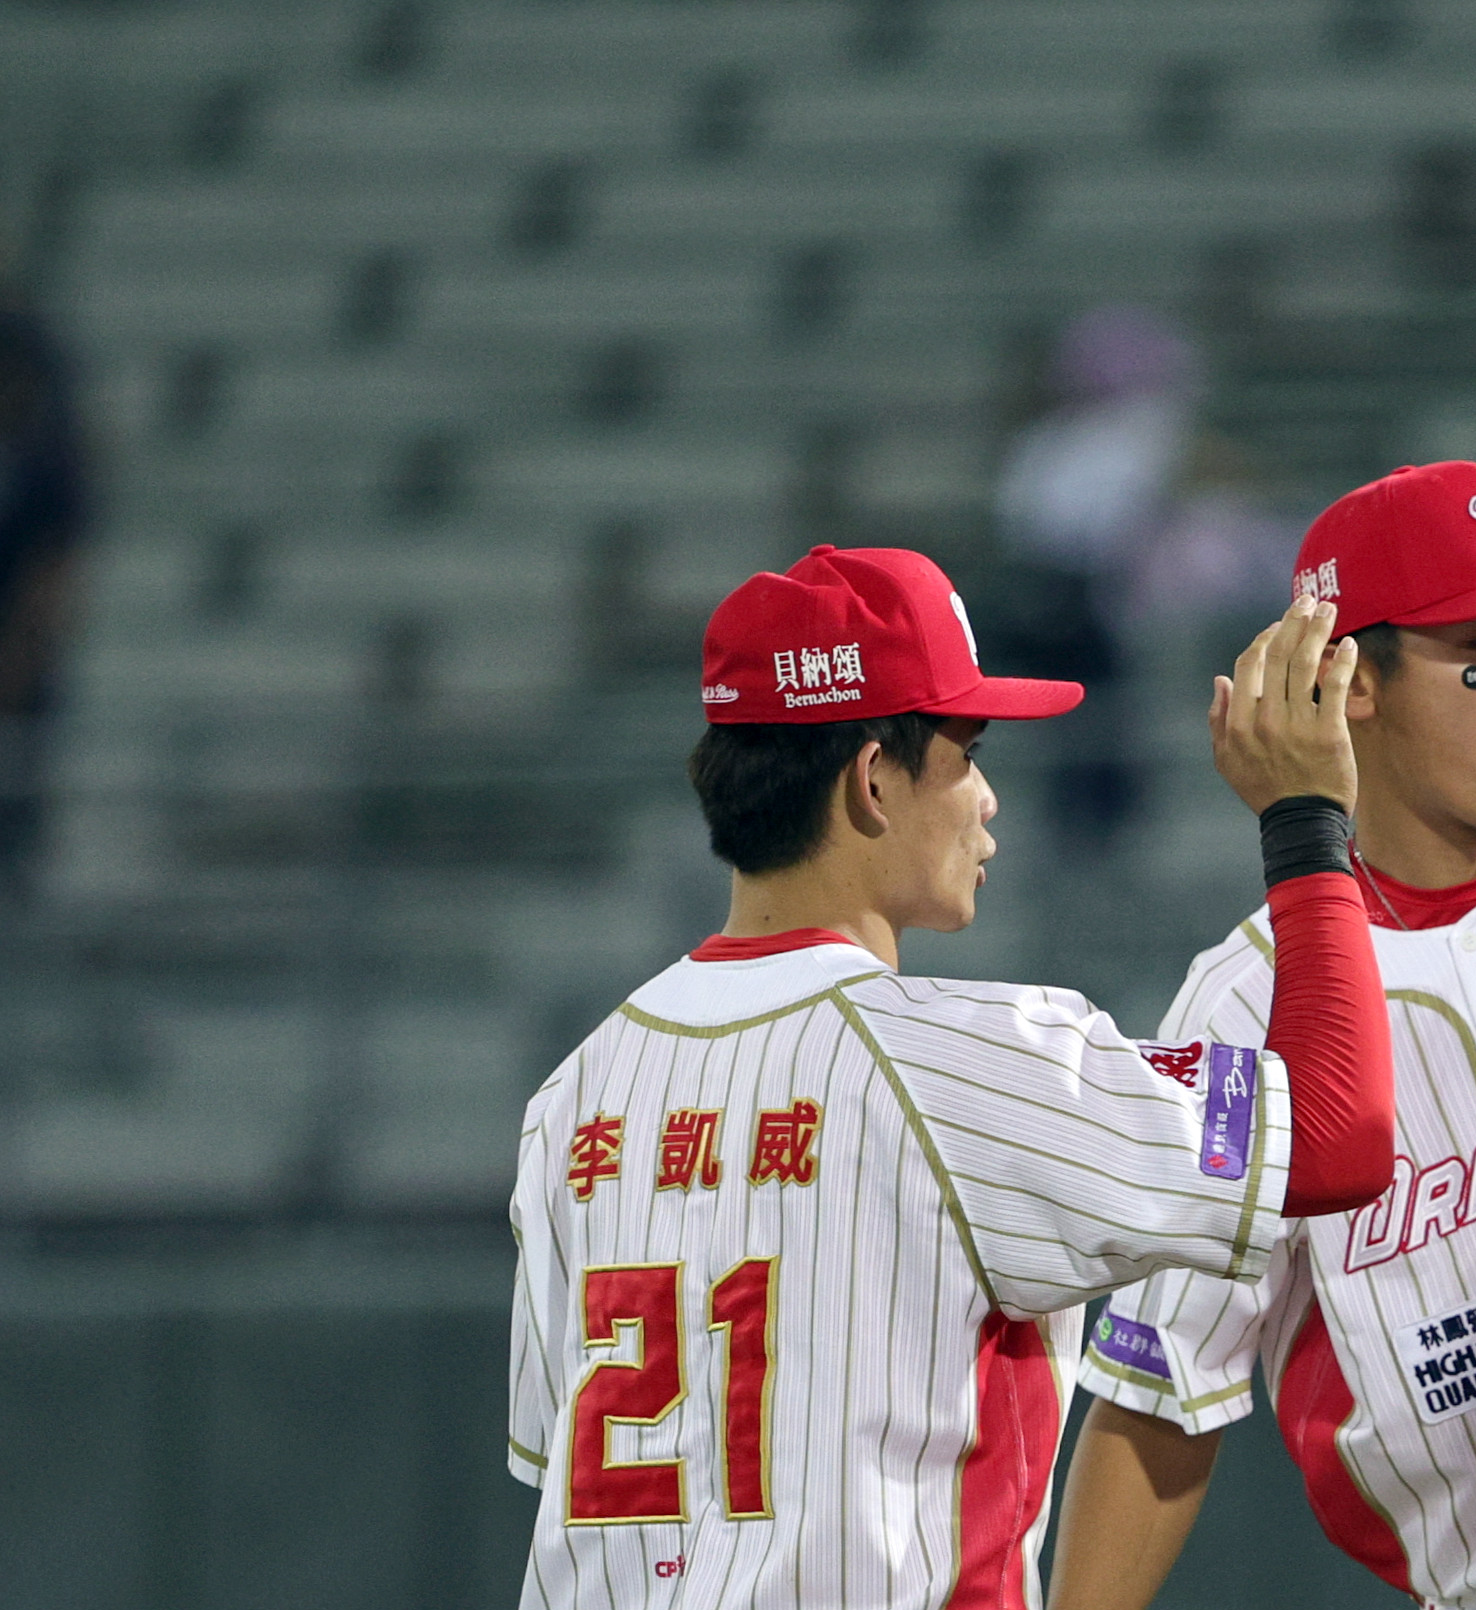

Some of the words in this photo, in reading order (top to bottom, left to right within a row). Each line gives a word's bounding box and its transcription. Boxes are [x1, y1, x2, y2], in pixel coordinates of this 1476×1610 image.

[773, 641, 866, 693] 貝納頌
[784, 686, 861, 709] Bernachon
[566, 1097, 824, 1202] 李凱威
[563, 1255, 780, 1527] 21
